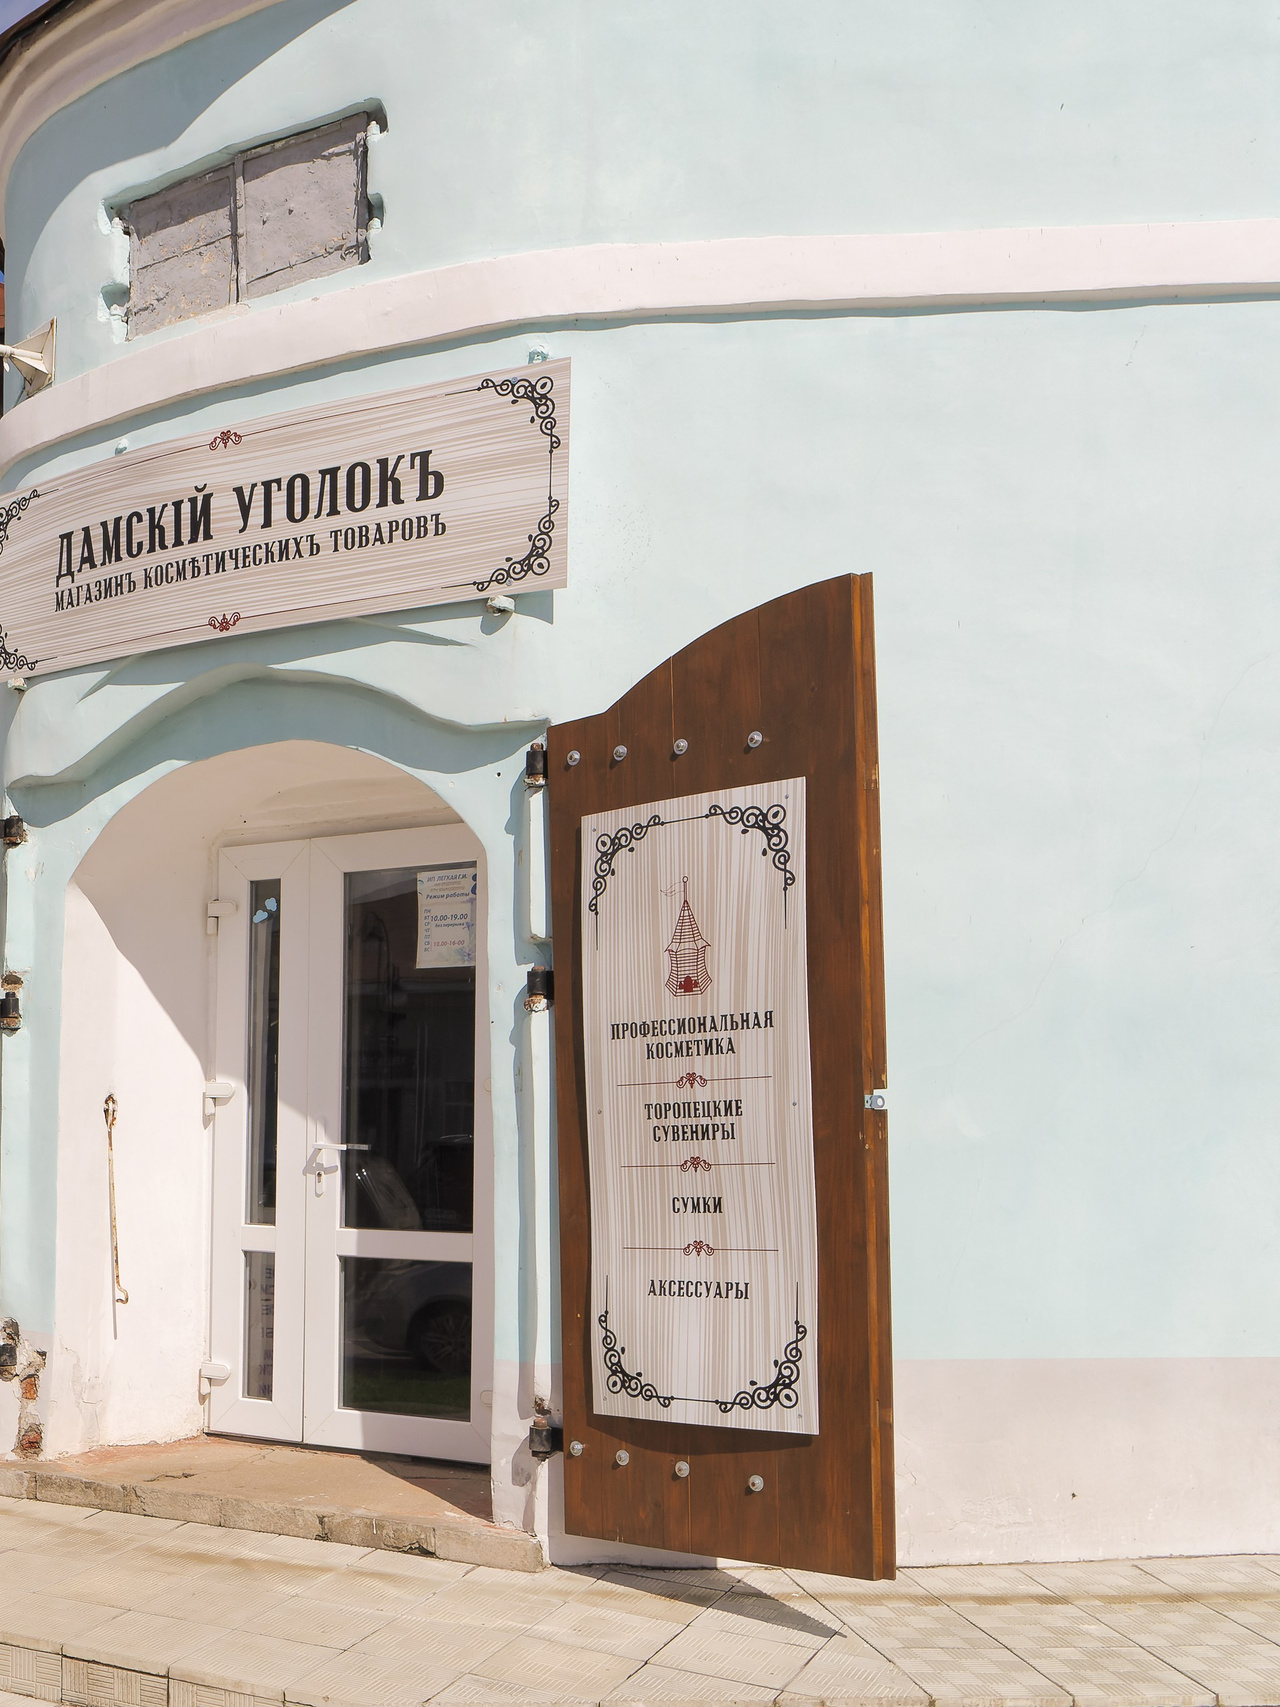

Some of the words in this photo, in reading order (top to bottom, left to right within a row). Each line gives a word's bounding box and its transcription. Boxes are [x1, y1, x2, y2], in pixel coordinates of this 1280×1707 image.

[55, 483, 213, 587] ДАМСКІЙ
[233, 450, 445, 533] УГОЛОКЪ
[55, 571, 137, 612] МАГАЗИНЪ
[329, 512, 448, 554] ТОВАРОВЪ
[430, 913, 469, 922] 10.00-19.00
[611, 1010, 775, 1040] ПРОФЕССИОНАЛЬНАЯ
[646, 1037, 736, 1060] КОСМЕТИКА
[644, 1099, 743, 1121] ТОРОПЕЦКИЕ
[652, 1122, 736, 1143] СУВЕНИРЫ
[671, 1196, 723, 1214] СУМКИ
[647, 1279, 750, 1300] АКСЕССУАРЫ
